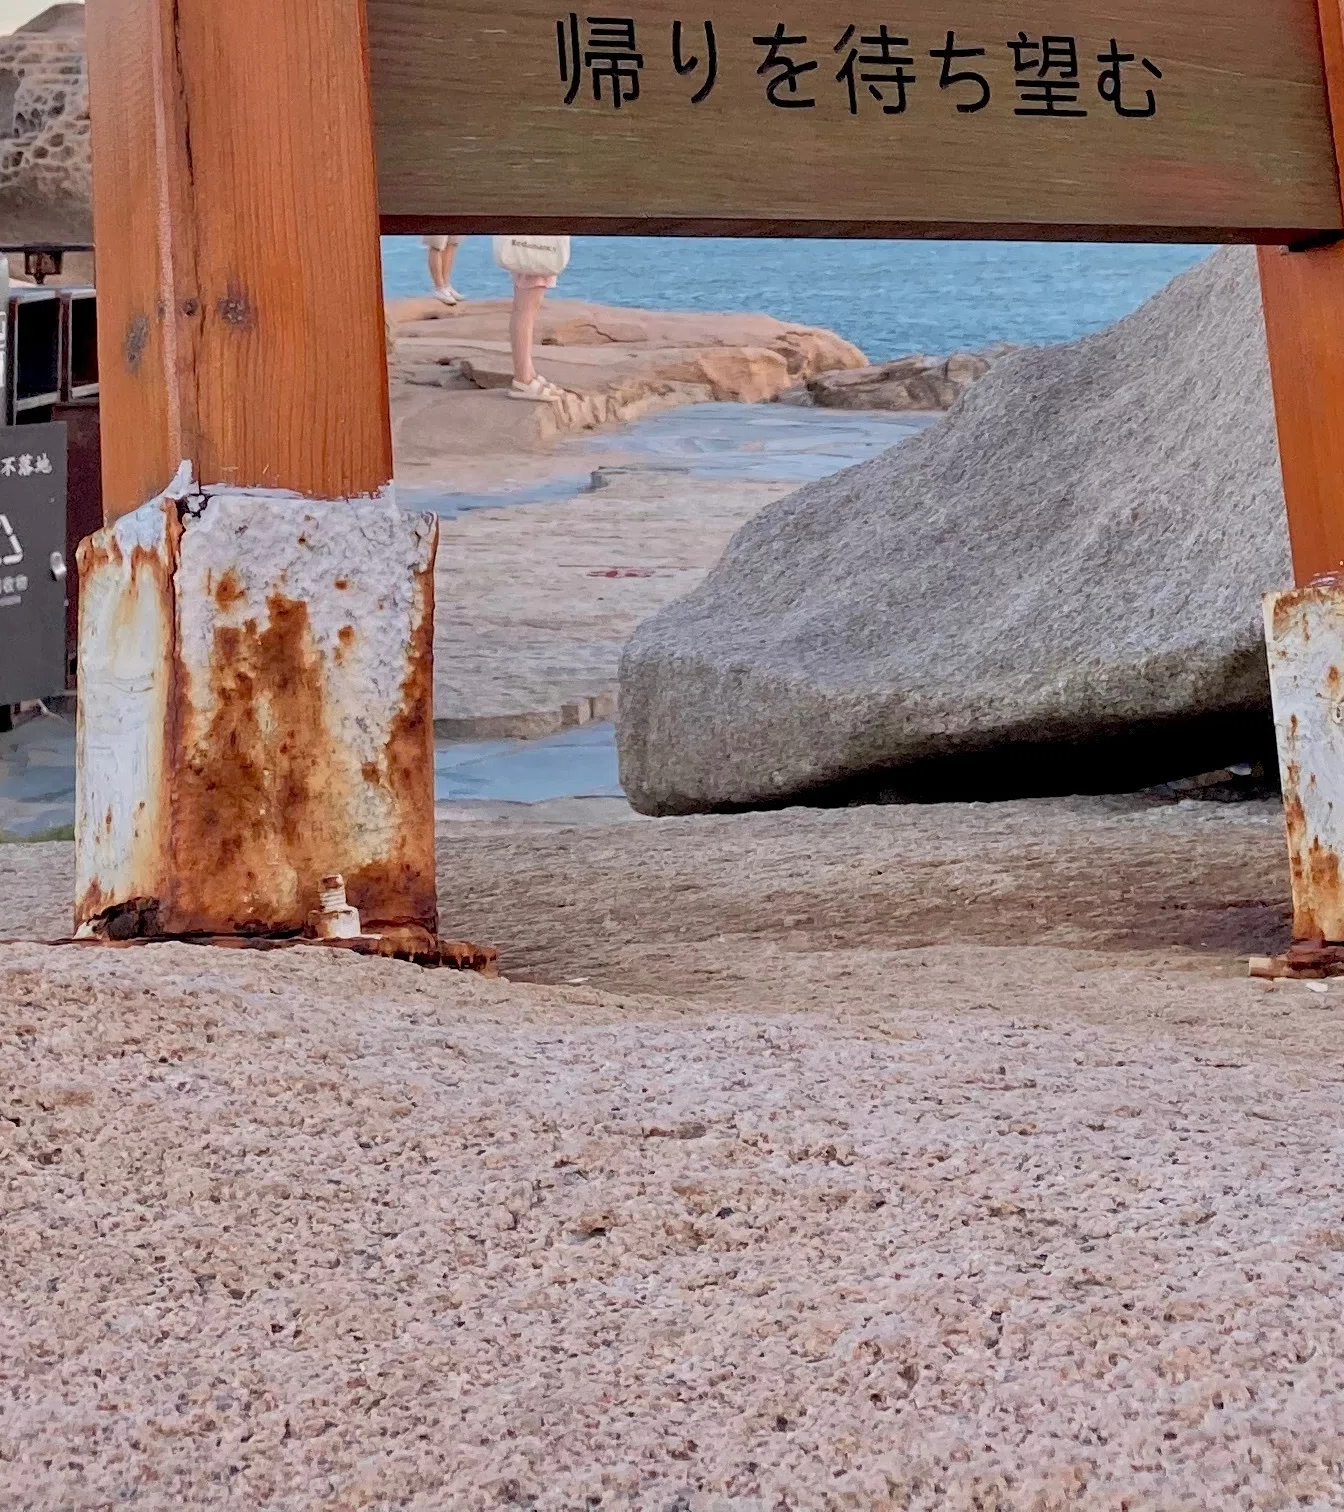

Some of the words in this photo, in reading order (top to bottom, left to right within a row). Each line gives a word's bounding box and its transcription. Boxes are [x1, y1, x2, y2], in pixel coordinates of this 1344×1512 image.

[555, 12, 1163, 119] 帰りを待ち望む
